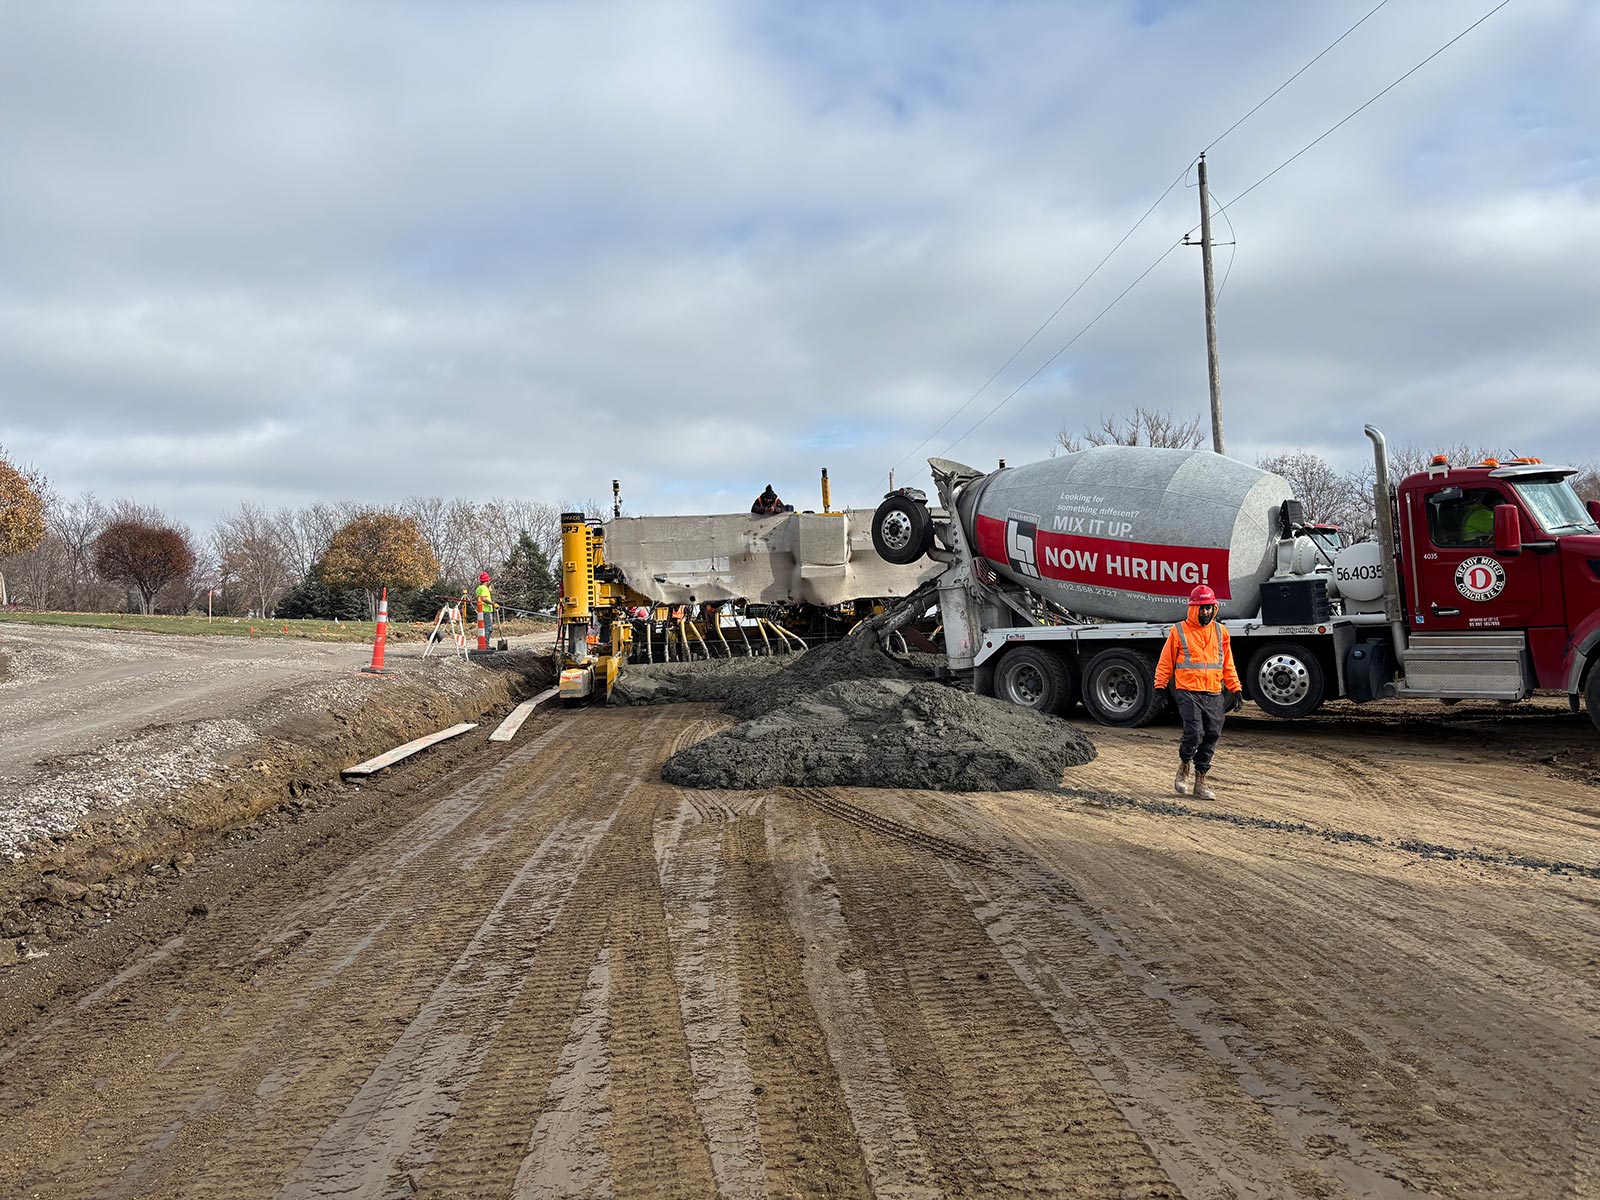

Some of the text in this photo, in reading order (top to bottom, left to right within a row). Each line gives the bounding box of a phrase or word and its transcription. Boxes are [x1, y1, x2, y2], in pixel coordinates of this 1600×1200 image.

[1060, 492, 1105, 503] Looking for
[1057, 504, 1140, 519] something different?
[1053, 515, 1085, 533] MIX
[1088, 519, 1105, 535] IT
[1108, 521, 1134, 539] UP.
[1044, 546, 1210, 585] NOW HIRING!
[1336, 565, 1383, 581] 56.4035
[1456, 557, 1503, 578] READY MIXED
[1469, 567, 1492, 590] D
[1125, 592, 1227, 607] www.lymanricm
[1457, 583, 1497, 600] CONCRETE
